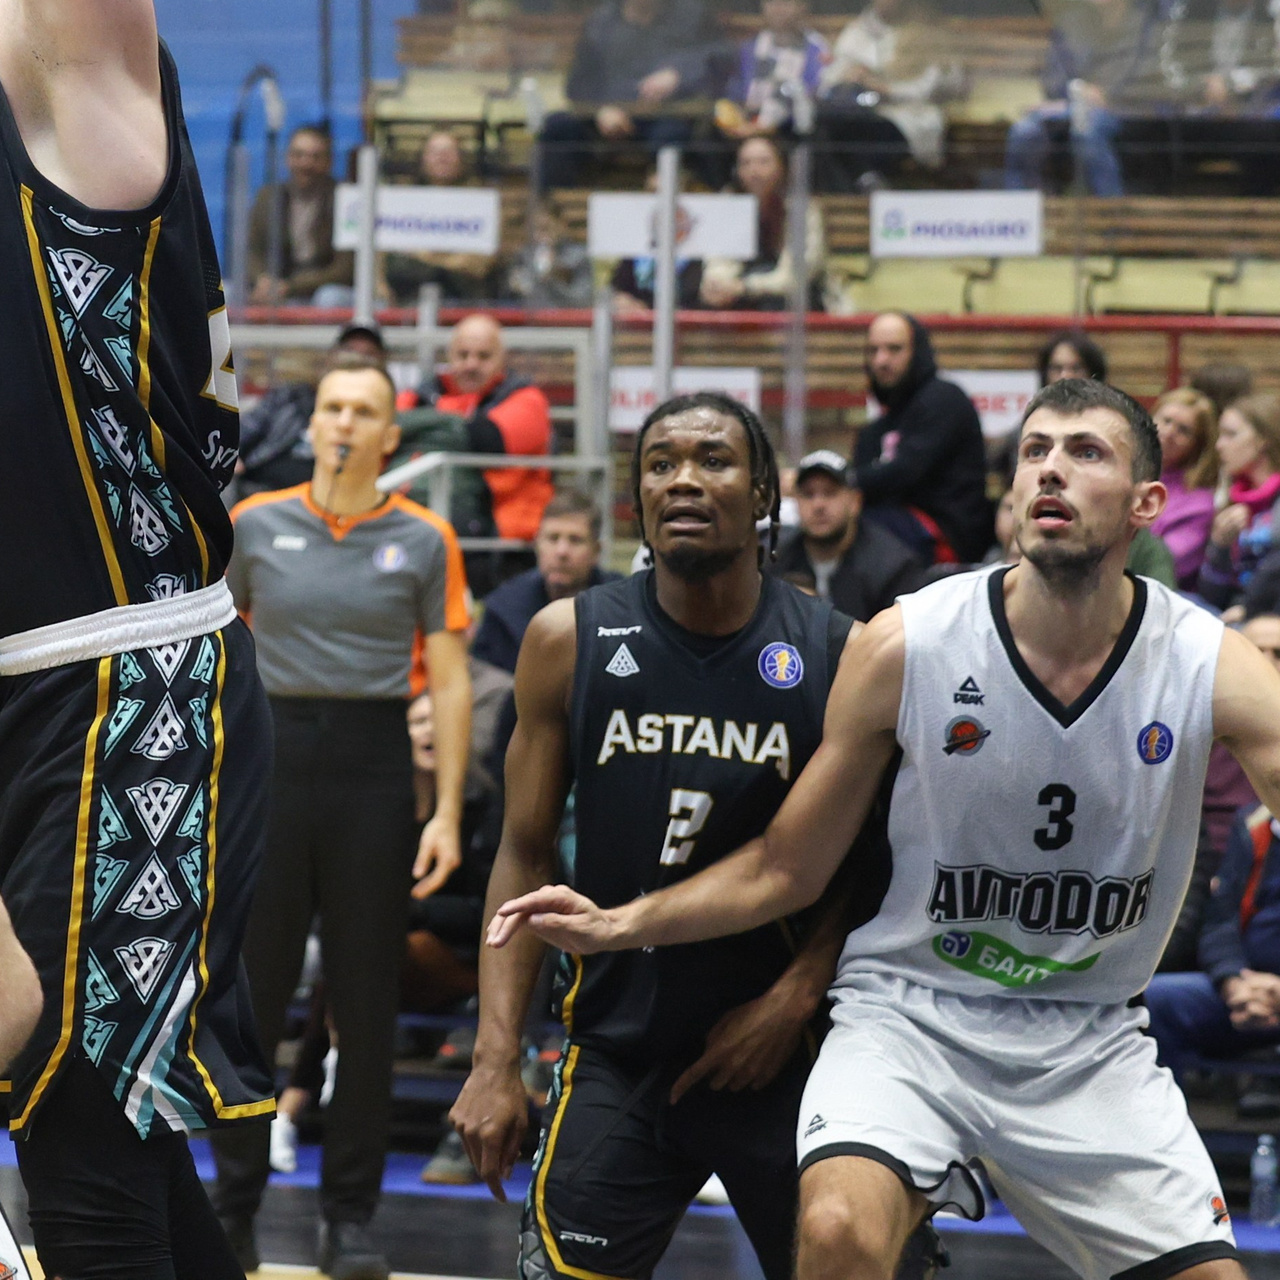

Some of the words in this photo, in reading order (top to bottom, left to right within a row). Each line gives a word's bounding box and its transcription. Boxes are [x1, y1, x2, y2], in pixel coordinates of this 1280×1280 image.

[910, 221, 1028, 240] PHOSAGRO
[953, 692, 985, 706] PEAK
[597, 708, 791, 781] ASTANA
[659, 787, 714, 866] 2
[1033, 783, 1077, 851] 3
[925, 859, 1155, 940] AVTODOR
